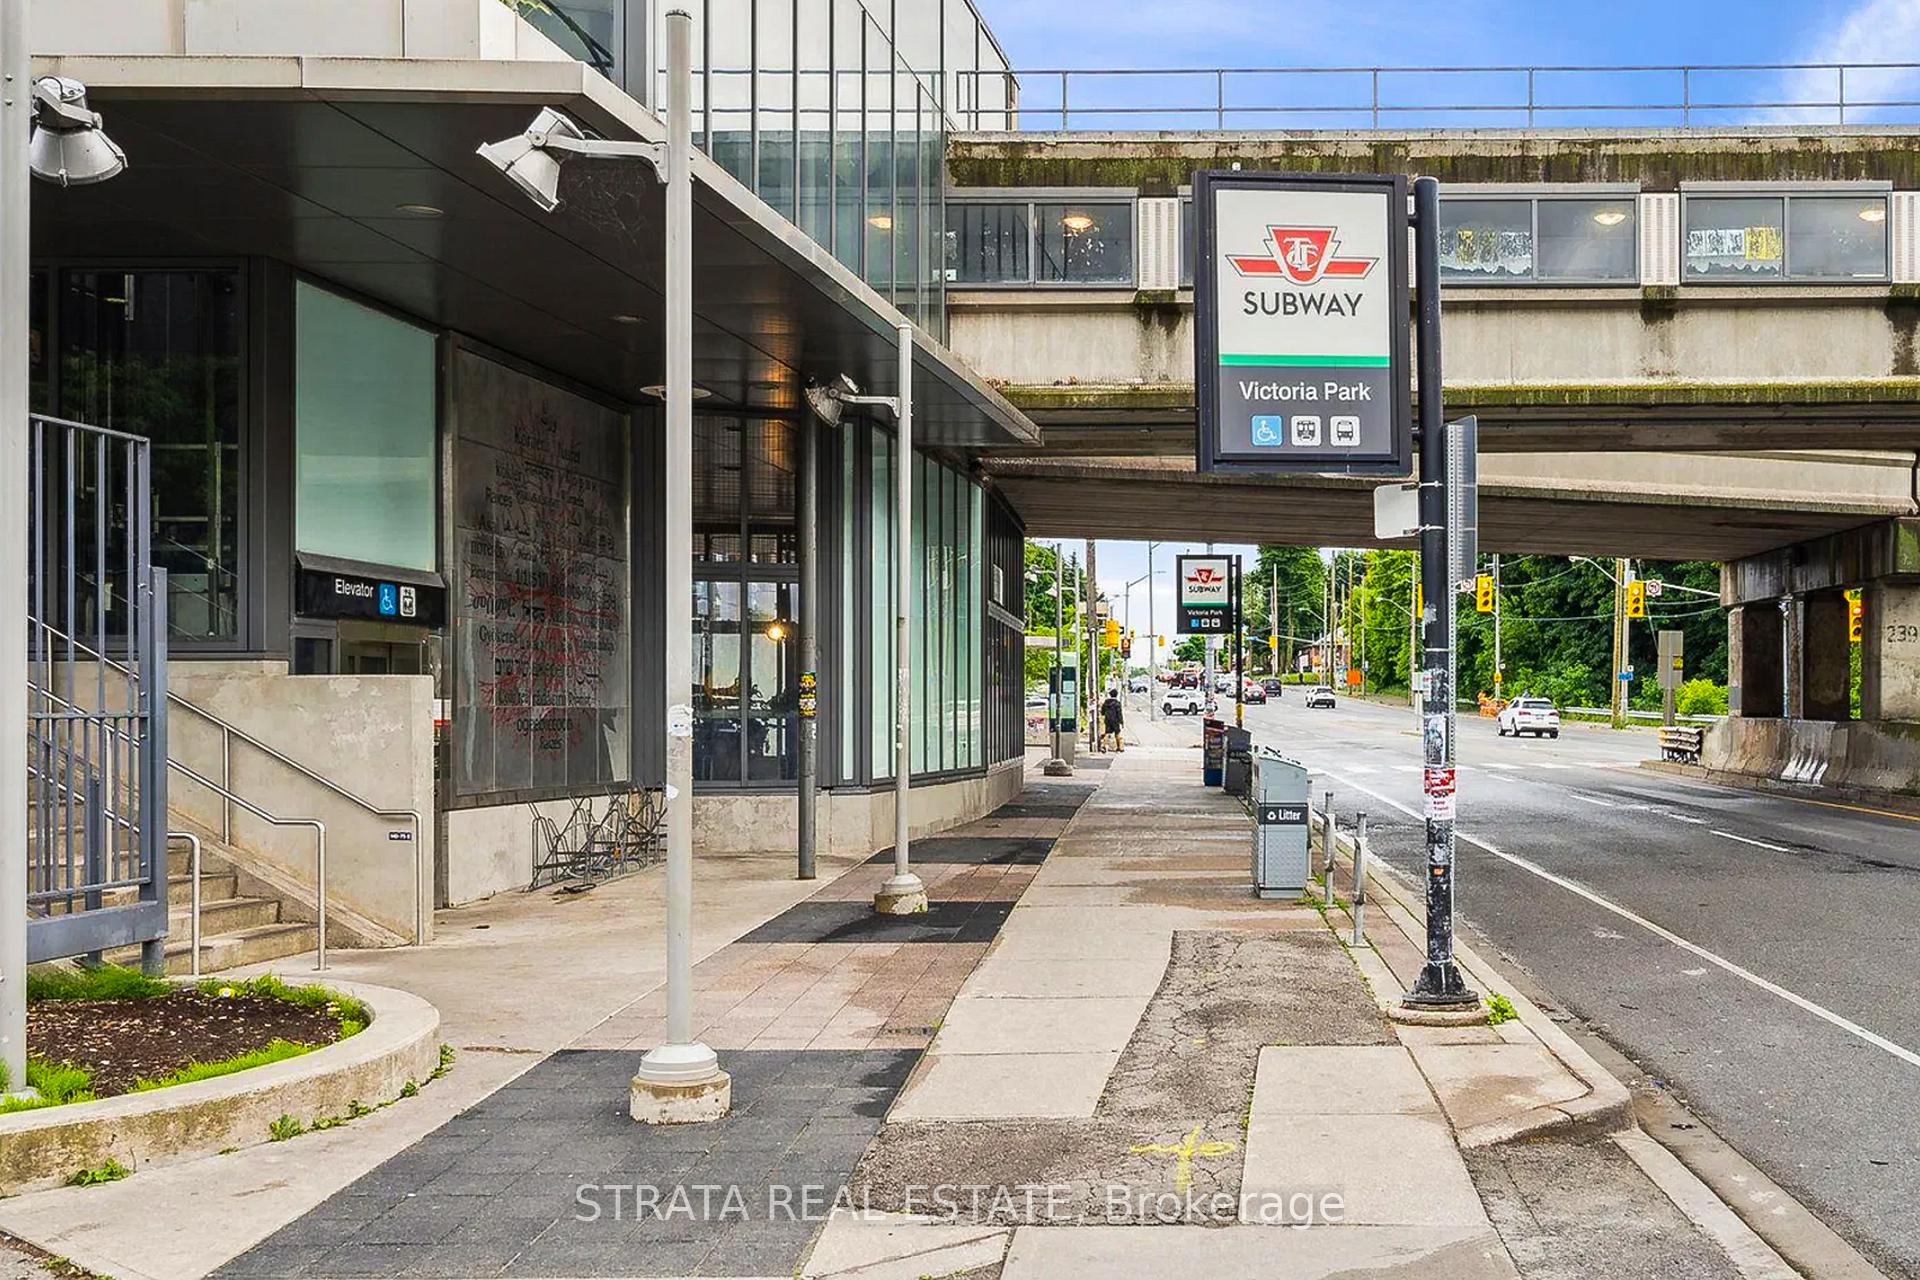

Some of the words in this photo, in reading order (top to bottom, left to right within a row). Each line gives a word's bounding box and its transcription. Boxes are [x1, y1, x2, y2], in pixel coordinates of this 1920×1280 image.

[1243, 291, 1364, 317] SUBWAY
[1238, 381, 1319, 401] Victoria
[1324, 382, 1372, 401] Park
[335, 578, 374, 597] Elevator
[1188, 585, 1222, 593] SUBWAY
[1886, 625, 1918, 643] 239
[1278, 808, 1302, 821] Litter
